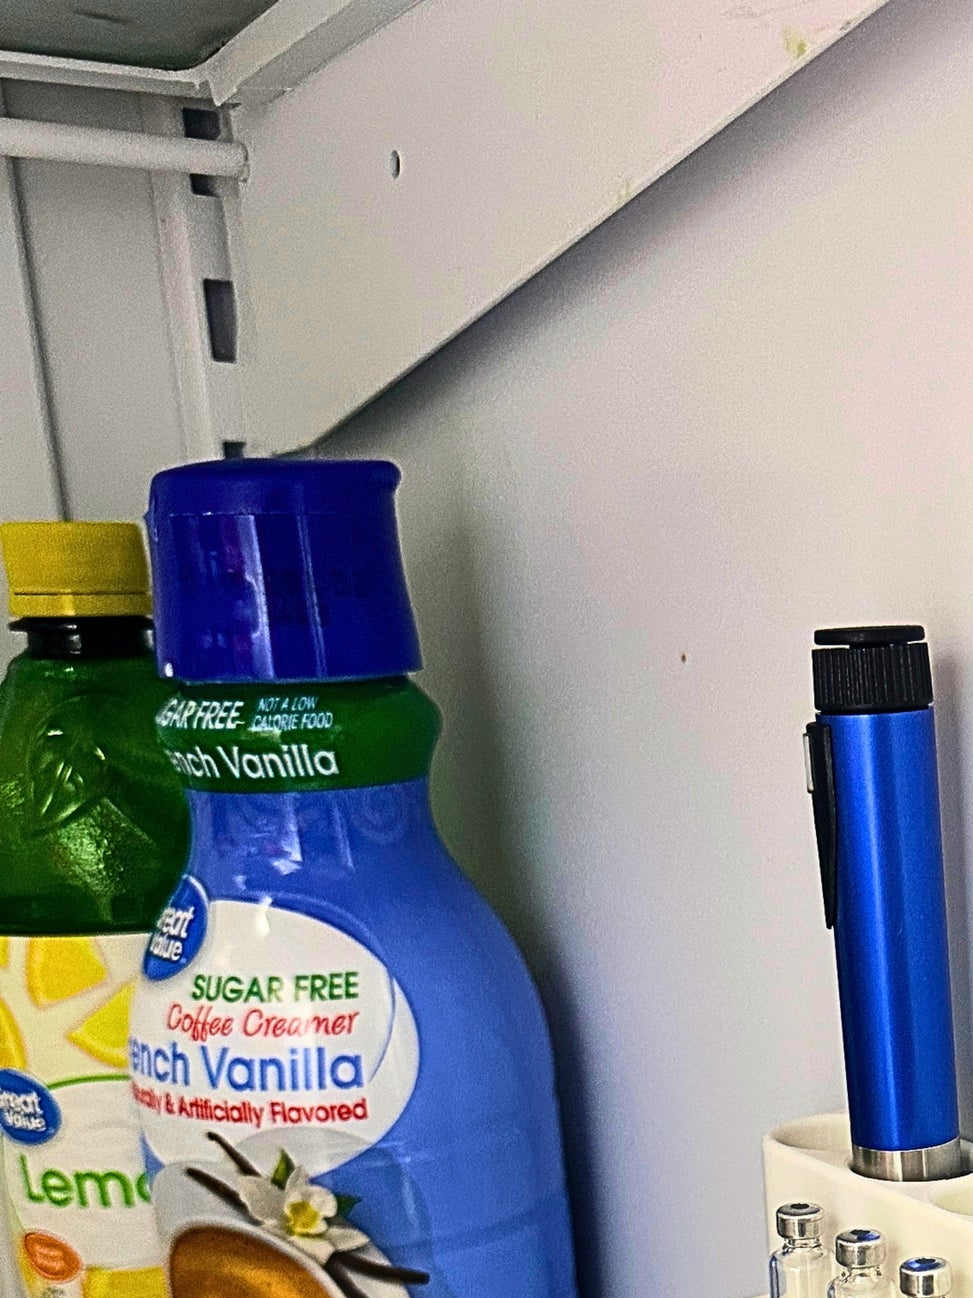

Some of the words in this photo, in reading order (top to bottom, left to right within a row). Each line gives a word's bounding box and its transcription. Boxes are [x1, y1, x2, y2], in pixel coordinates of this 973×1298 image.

[193, 701, 245, 730] FREE
[252, 714, 297, 732] CALORIE
[300, 713, 333, 730] FOOD
[216, 744, 339, 779] Vanilla
[191, 973, 284, 1003] SUGAR
[294, 971, 359, 1002] FREE
[166, 1003, 235, 1041] Coffee
[200, 1045, 365, 1092] Vanilla
[178, 1095, 264, 1128] Artificially
[270, 1097, 368, 1123] Flavored
